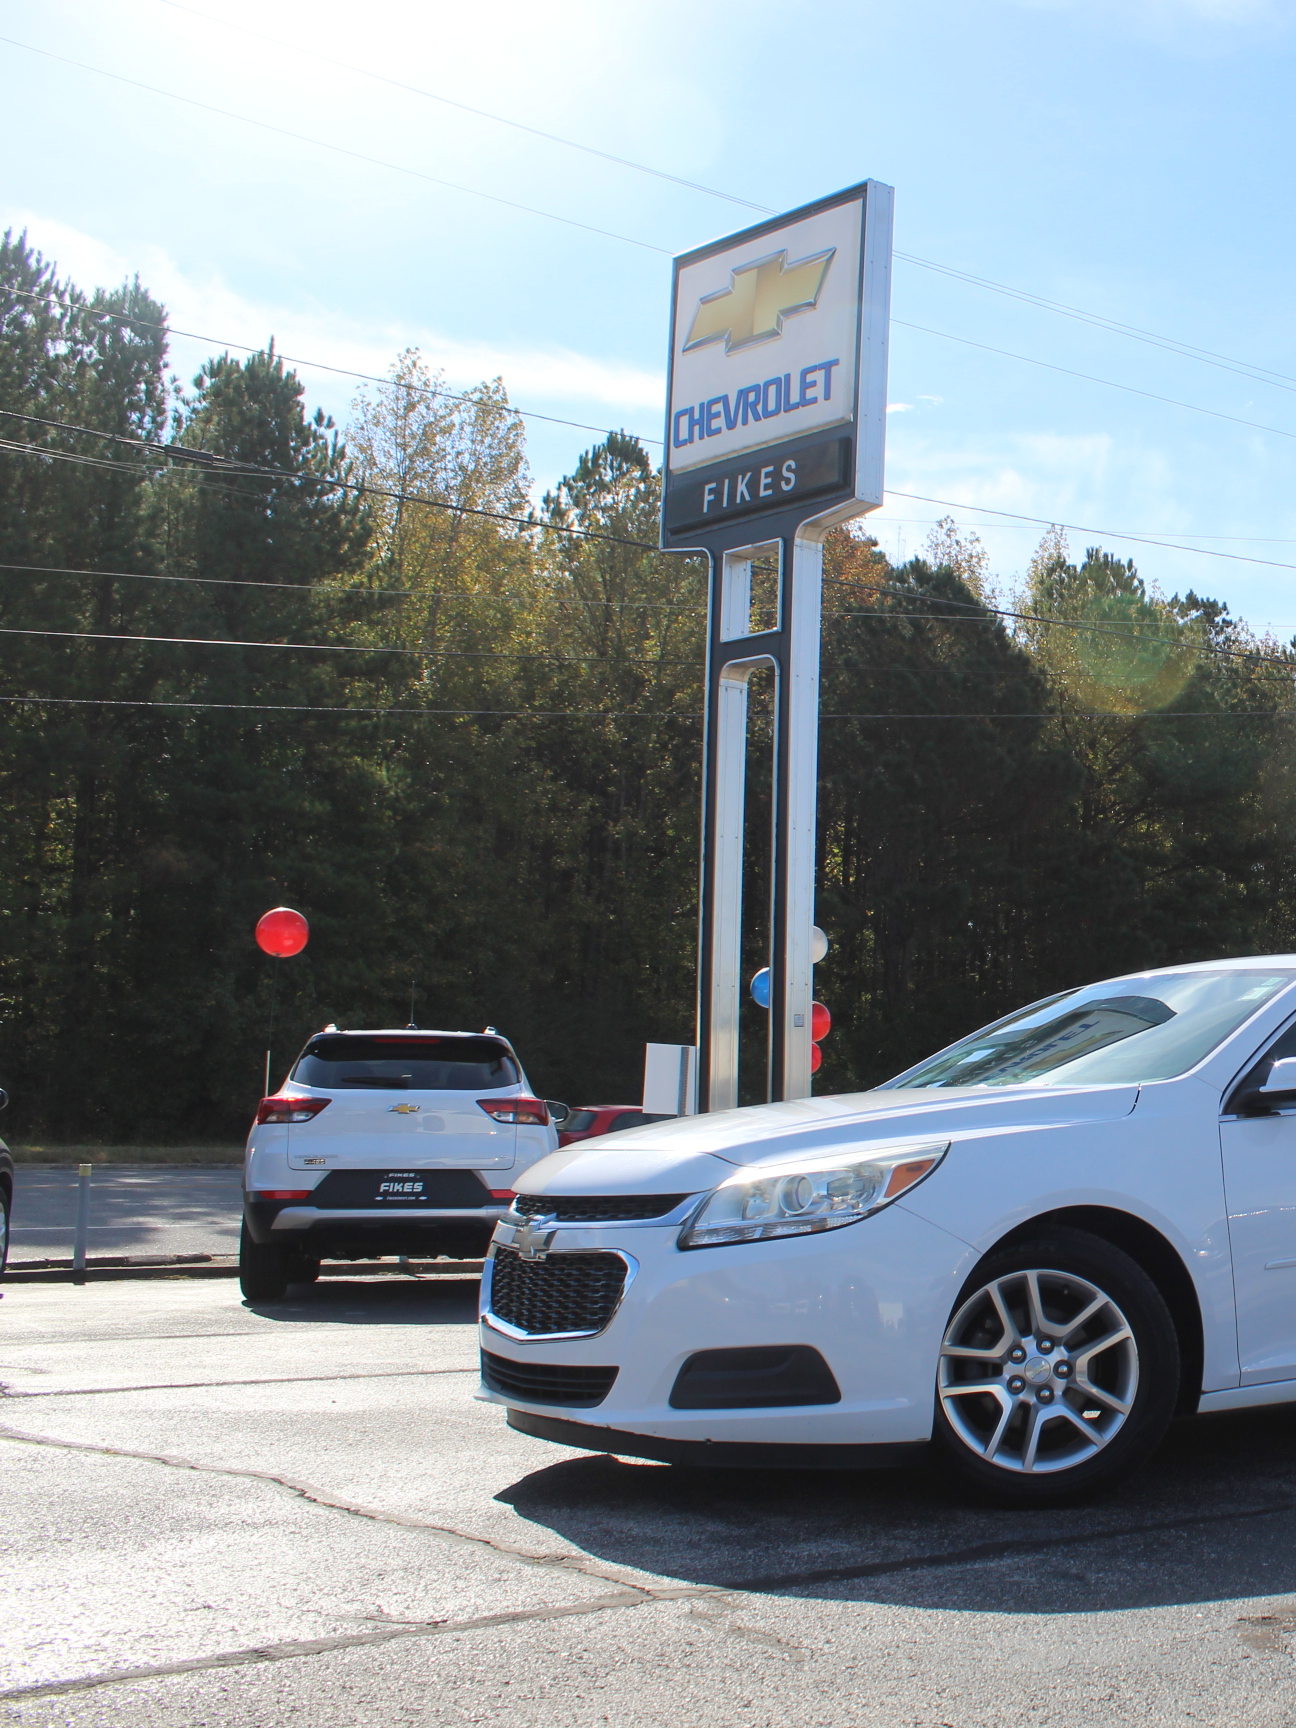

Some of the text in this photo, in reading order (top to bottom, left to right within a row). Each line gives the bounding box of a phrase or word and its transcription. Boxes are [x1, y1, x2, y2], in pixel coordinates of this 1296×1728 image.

[673, 358, 840, 449] CHEVROLET
[703, 459, 797, 514] FIKES
[379, 1182, 424, 1193] FIKES
